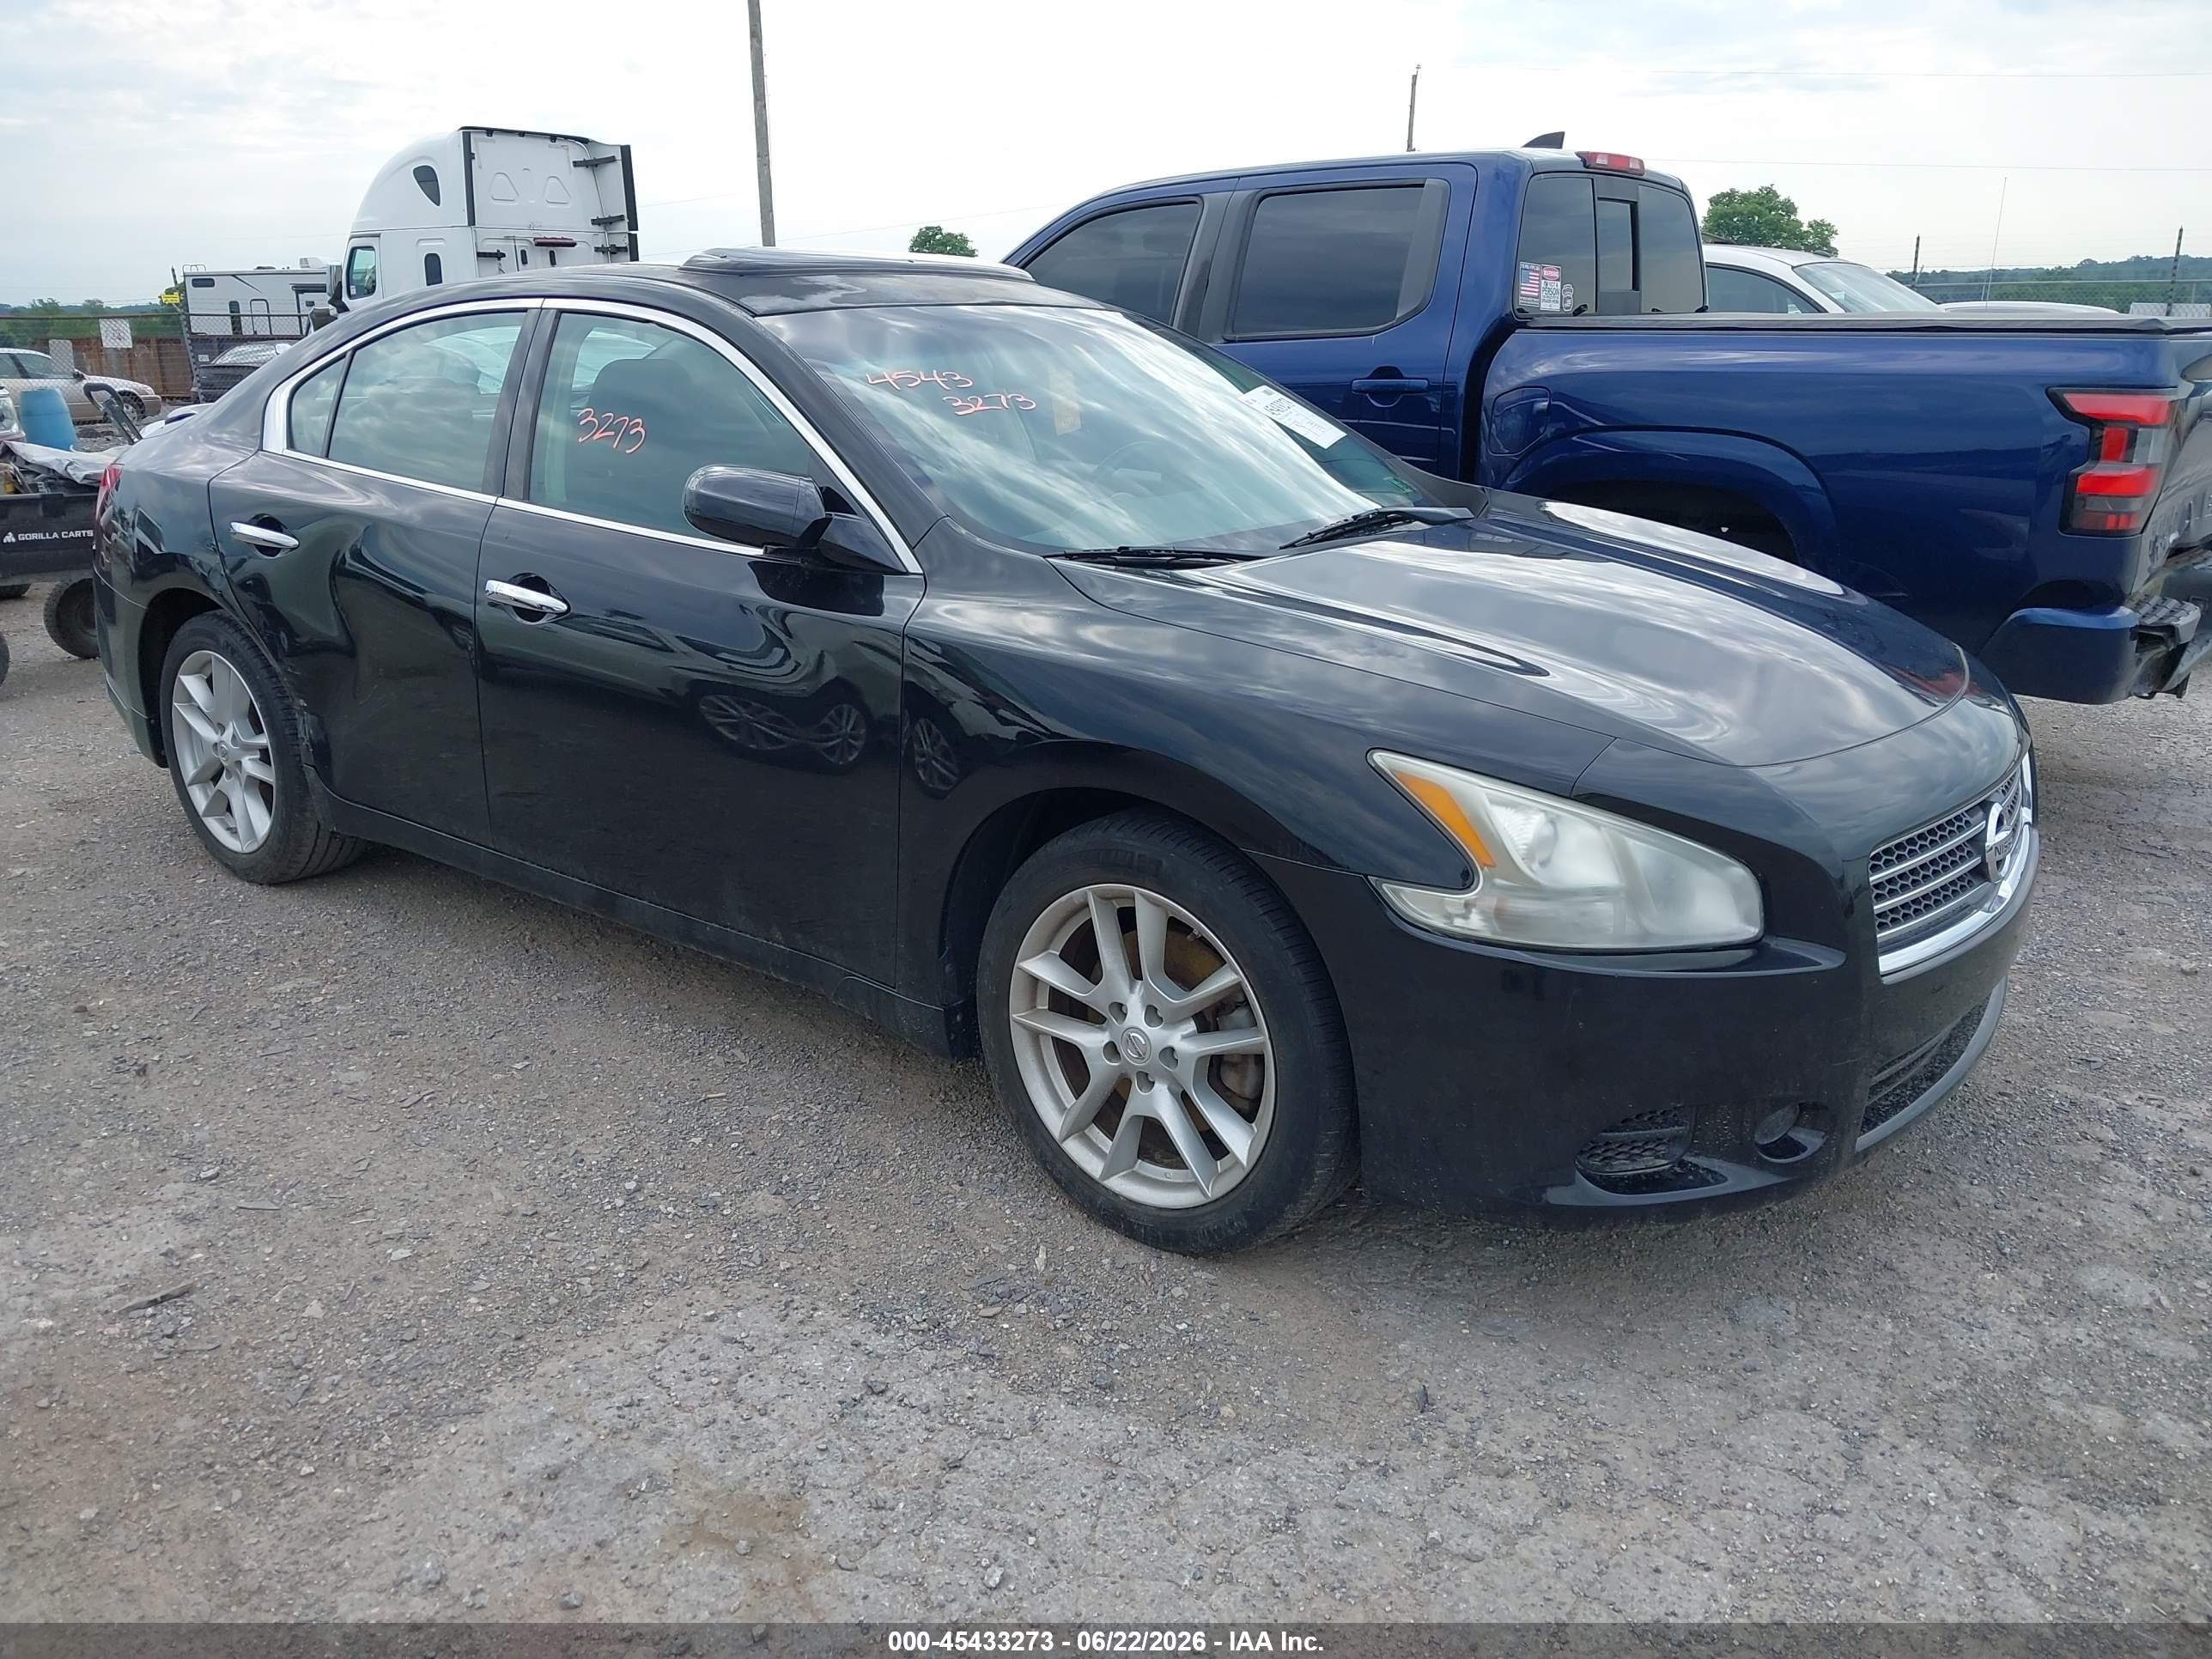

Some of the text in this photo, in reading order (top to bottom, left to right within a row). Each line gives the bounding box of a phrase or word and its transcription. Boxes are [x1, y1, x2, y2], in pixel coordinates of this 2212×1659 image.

[866, 369, 974, 391] 4543
[942, 393, 1037, 416] 3273
[576, 407, 646, 454] 3273
[17, 530, 94, 541] GORILLA CARTS
